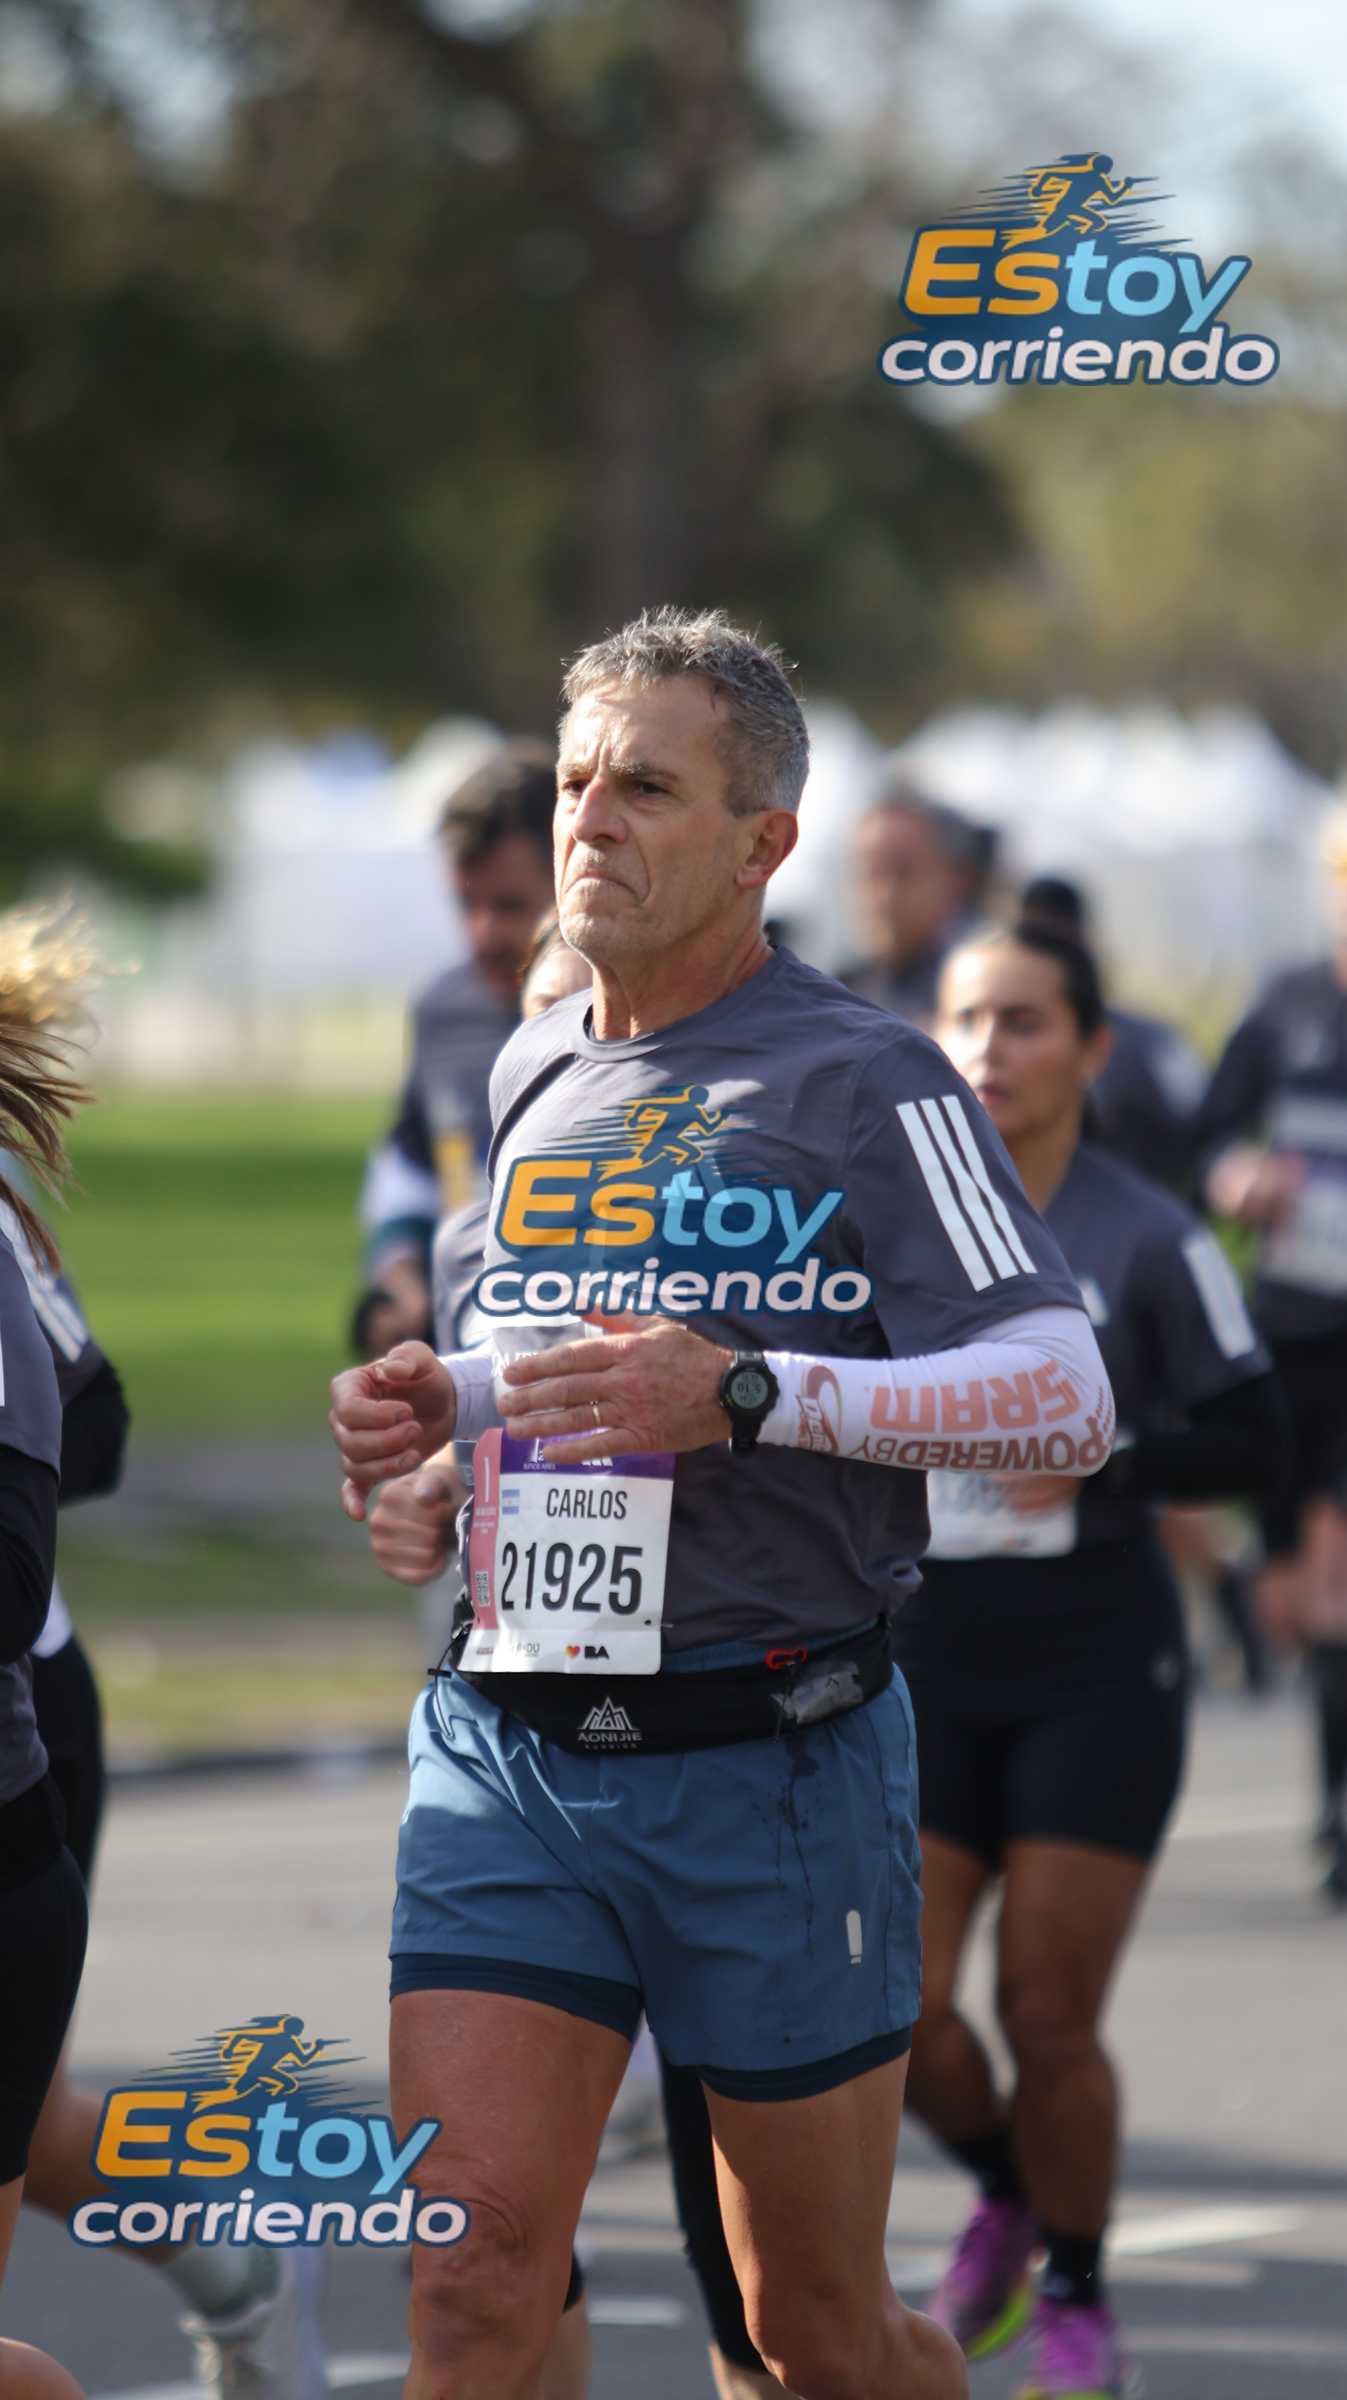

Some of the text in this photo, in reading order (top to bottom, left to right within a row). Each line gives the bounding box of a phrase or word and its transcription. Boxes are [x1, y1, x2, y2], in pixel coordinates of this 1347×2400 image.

[869, 1359, 1081, 1434] SRAM
[546, 1488, 628, 1521] CARLOS
[501, 1541, 643, 1616] 21925
[584, 1646, 610, 1660] BA
[577, 1732, 643, 1742] AONIJIE
